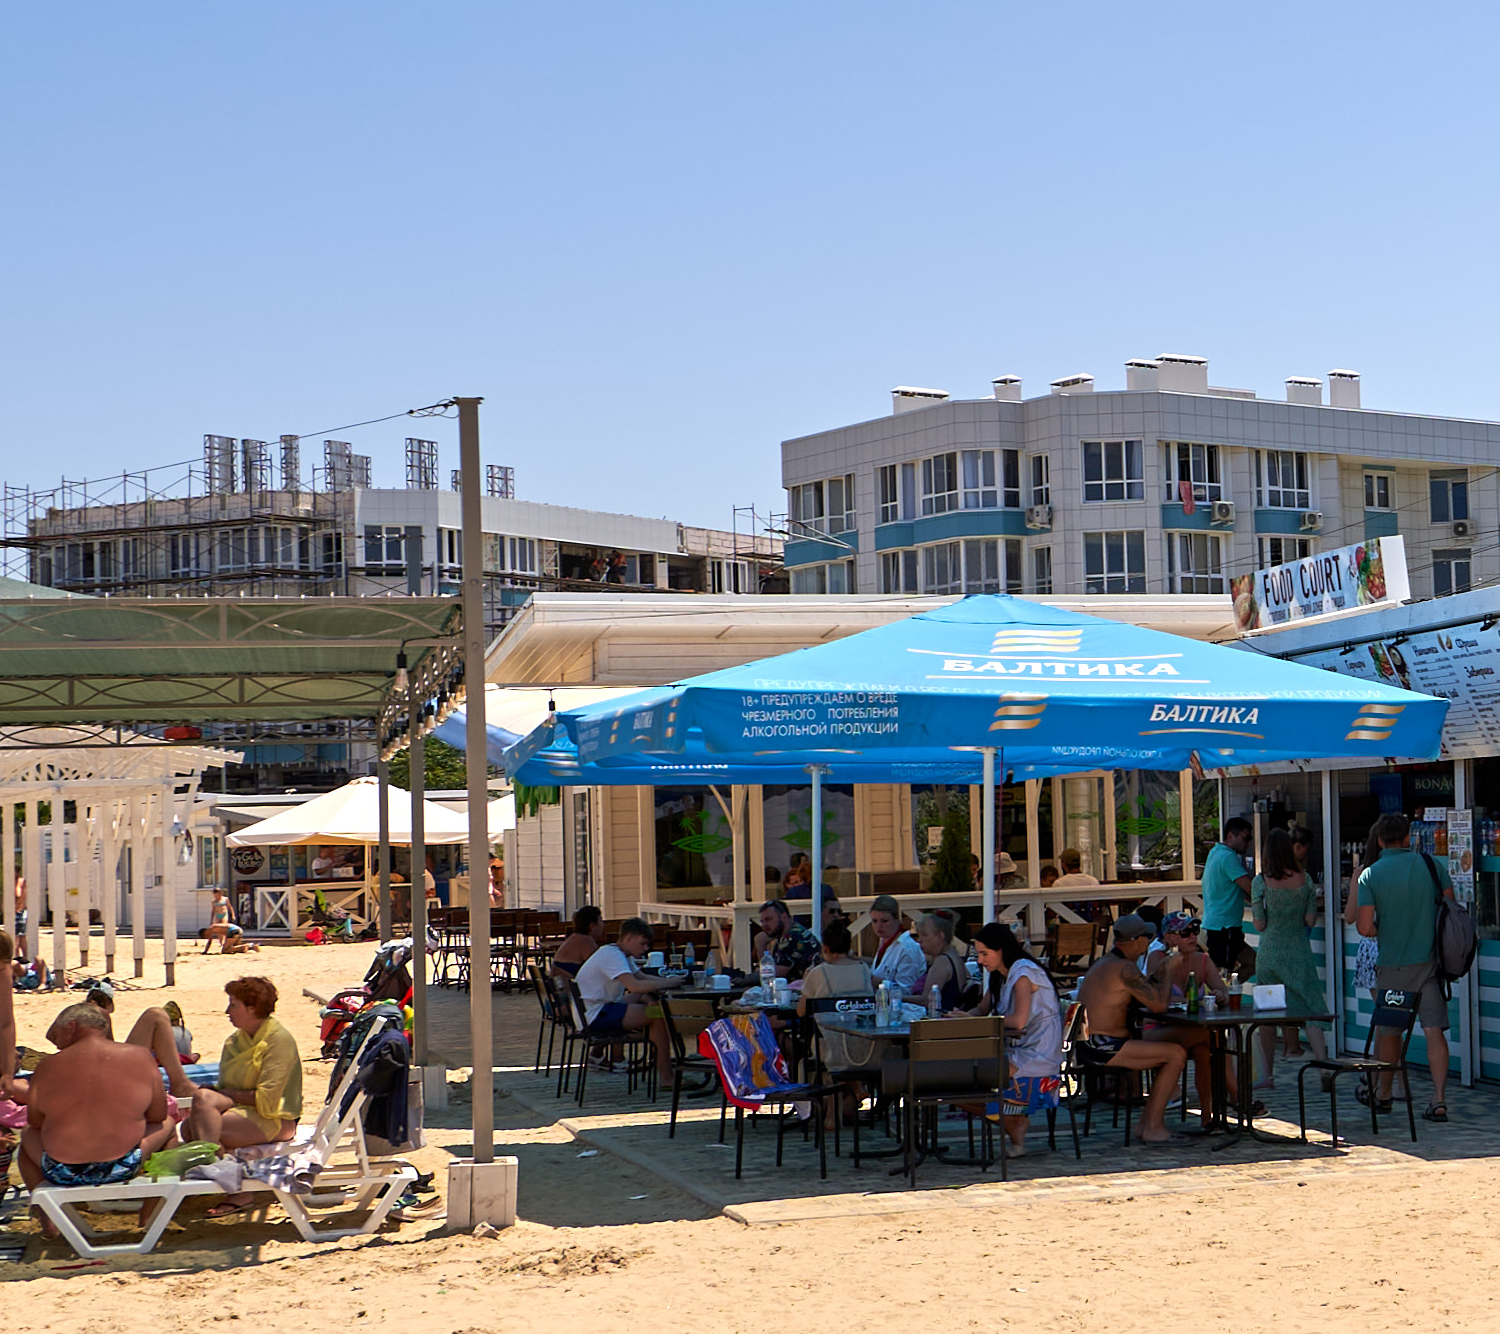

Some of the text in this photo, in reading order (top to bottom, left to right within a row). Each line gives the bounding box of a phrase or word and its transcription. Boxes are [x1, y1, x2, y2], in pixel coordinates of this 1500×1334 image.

[1263, 555, 1342, 607] FOOD COURT
[942, 658, 1181, 677] БАЛТИКА
[741, 691, 898, 708] 18+ ПРЕДУПРЕЖДАЕМ О ВРЕДЕ
[741, 706, 899, 722] ЧРЕЗМЕРНОГО ПОТРЕБЛЕНИЯ
[1149, 703, 1260, 725] БАЛТИКА
[742, 722, 899, 738] АЛКОГОЛЬНОЙ ПРОДУКЦИИ
[834, 998, 876, 1013] Carlsberg
